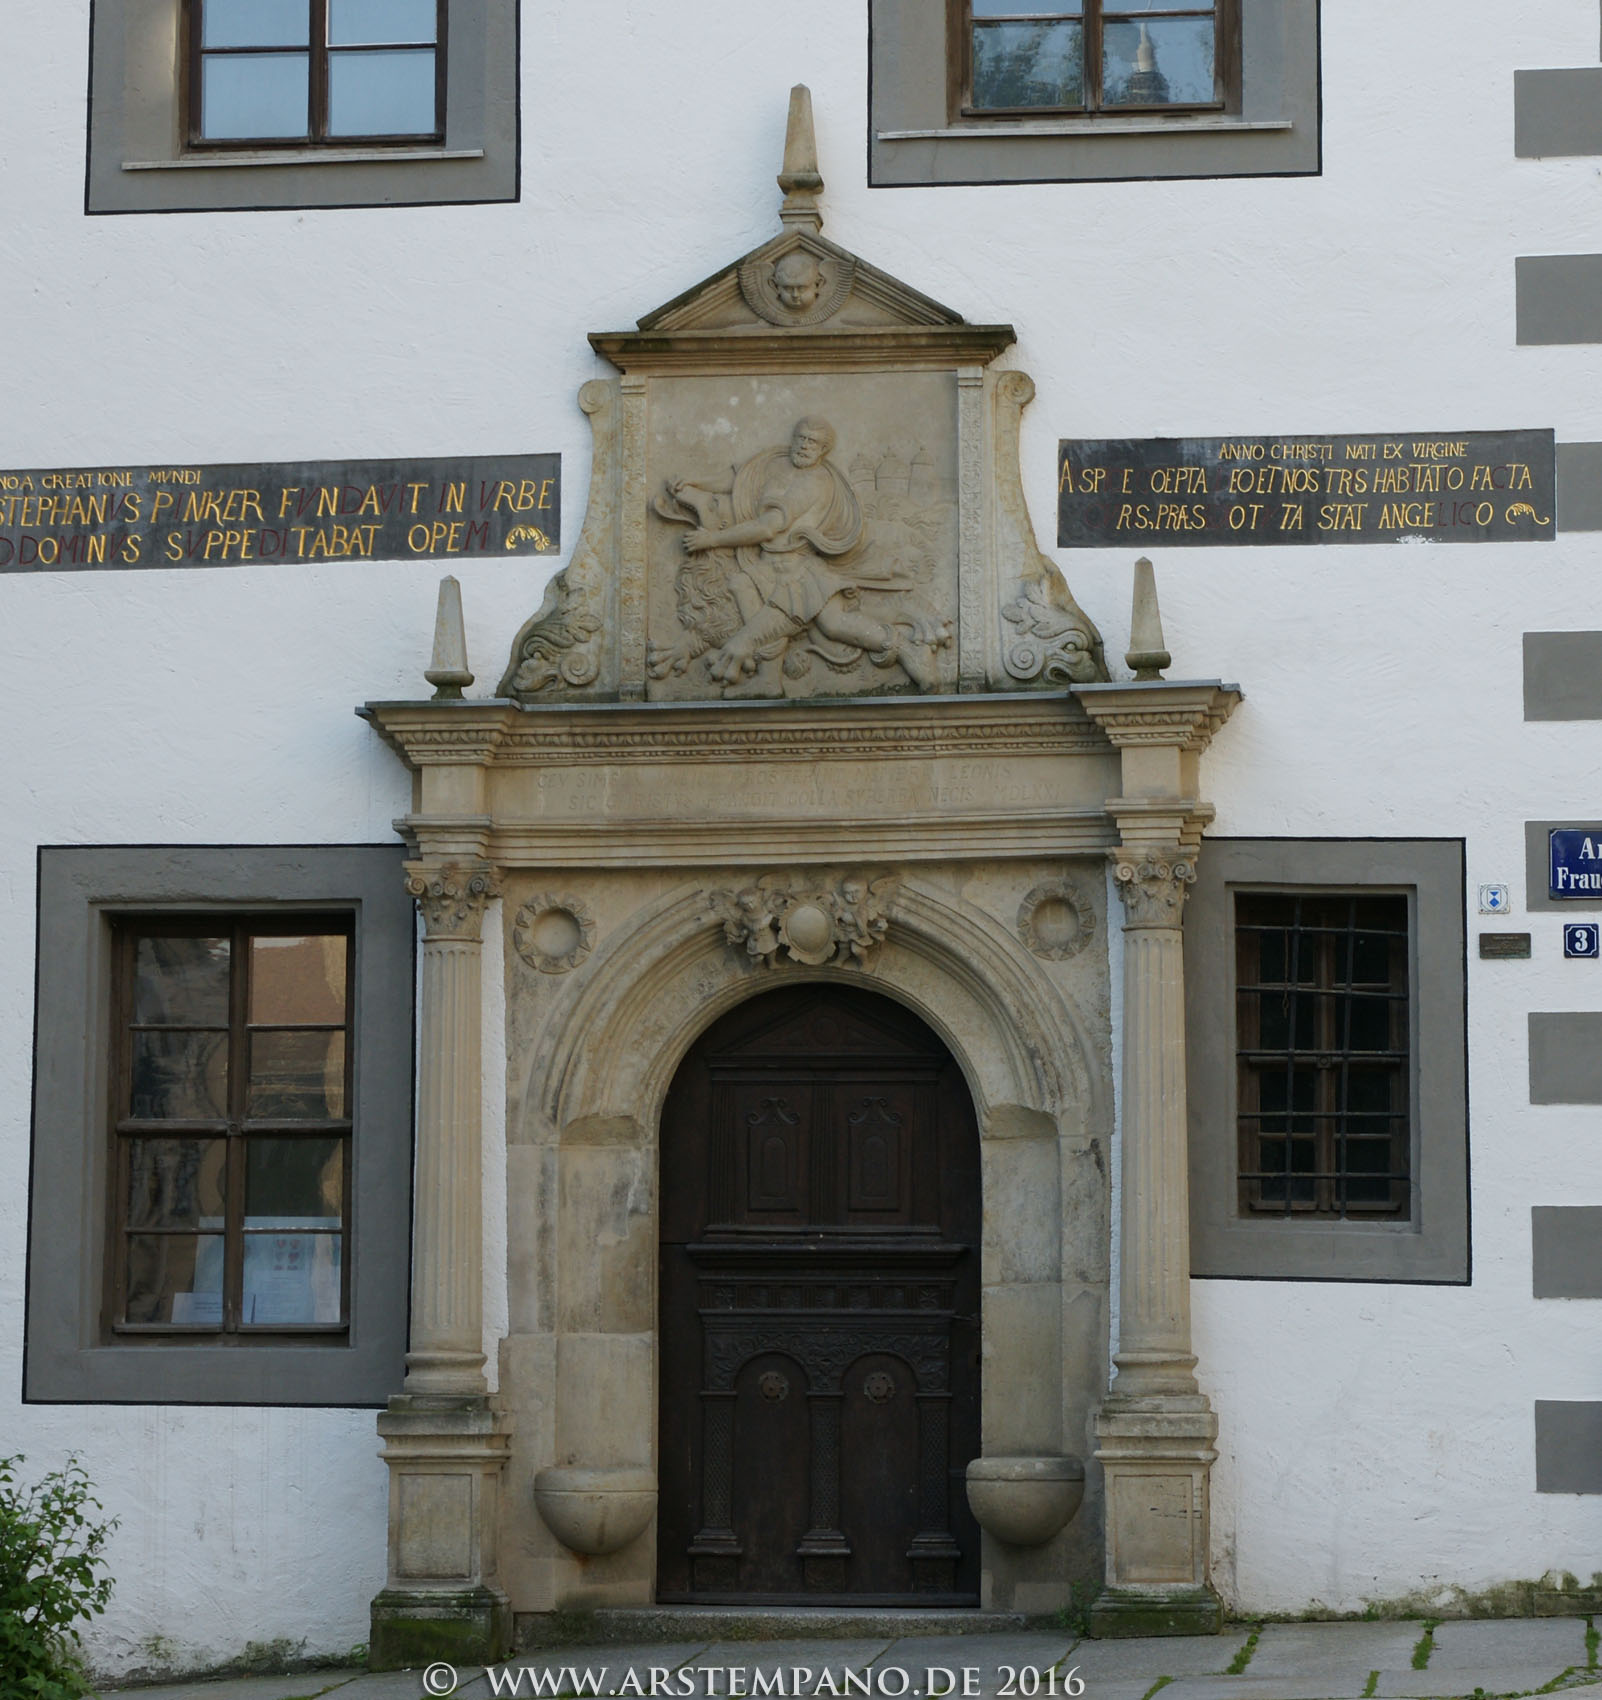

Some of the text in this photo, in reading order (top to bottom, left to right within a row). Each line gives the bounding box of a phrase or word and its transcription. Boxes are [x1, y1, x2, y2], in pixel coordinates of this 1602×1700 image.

[1219, 441, 1470, 462] ANNO CHRISTI NATI EX VIRGINE
[41, 471, 133, 489] CREATIONE
[148, 469, 201, 485] MVNDI
[479, 479, 555, 512] VRBE
[1316, 503, 1368, 530] STAT
[408, 521, 490, 553] OPEM
[1574, 929, 1588, 951] 3
